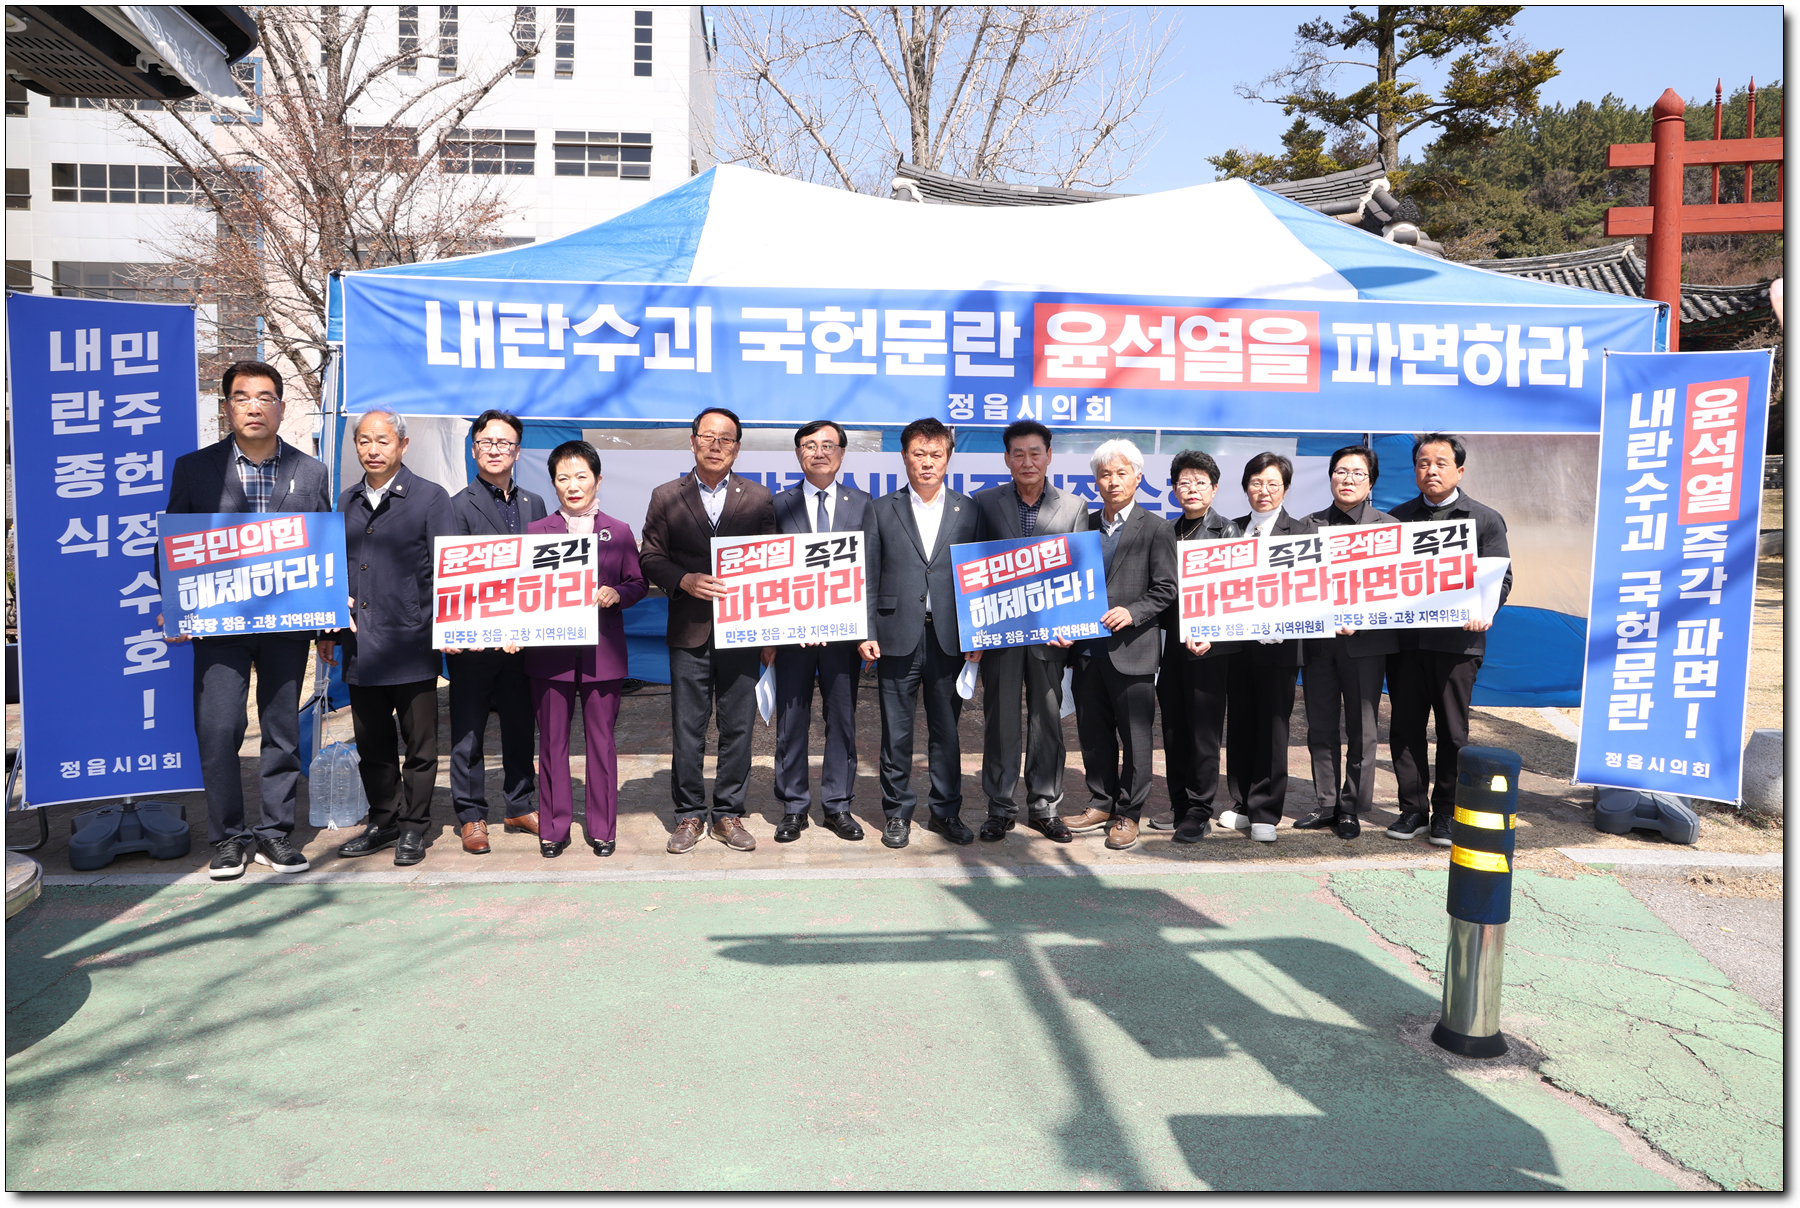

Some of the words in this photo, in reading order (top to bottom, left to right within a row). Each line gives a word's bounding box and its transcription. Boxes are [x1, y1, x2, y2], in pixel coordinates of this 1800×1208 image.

[425, 300, 713, 373] 내란수괴
[739, 306, 1020, 378] 국헌문란
[1044, 311, 1310, 385] 윤석열을
[1332, 322, 1589, 389] 파면하라
[948, 393, 1112, 424] 정읍시의회
[49, 328, 109, 558] 내란종식
[1686, 388, 1738, 514] 윤석열
[1621, 388, 1676, 551] 내란수괴
[172, 516, 304, 565] 국민의힘
[442, 540, 518, 575] 윤석열
[532, 537, 591, 570] 즉각
[720, 540, 791, 576] 윤석열
[805, 535, 858, 569] 즉각
[1185, 542, 1254, 575] 윤석열
[1268, 537, 1323, 569] 즉각
[1330, 528, 1398, 557] 윤석열
[1413, 523, 1470, 556] 즉각
[962, 538, 1068, 588] 국민의힘
[1331, 553, 1478, 606] 파면하라
[1678, 524, 1729, 605] 즉각
[436, 569, 597, 623] 파면하라
[717, 566, 865, 624] 파면하라
[1182, 566, 1331, 619] 파면하라
[178, 615, 218, 634] 민주당
[280, 611, 336, 628] 지역위원회
[444, 630, 478, 644] 민주당
[535, 627, 587, 640] 지역위원회
[725, 629, 757, 644] 민주당
[810, 622, 858, 637] 지역위원회
[971, 633, 1002, 648] 민주당
[1052, 622, 1099, 638] 지역위원회
[1190, 625, 1221, 638] 민주당
[1275, 620, 1325, 634] 지역위원회
[1419, 608, 1470, 623] 지역위원회
[1608, 570, 1662, 731] 국헌문란
[60, 752, 182, 779] 정읍시의회
[1605, 752, 1710, 778] 정읍시의회
